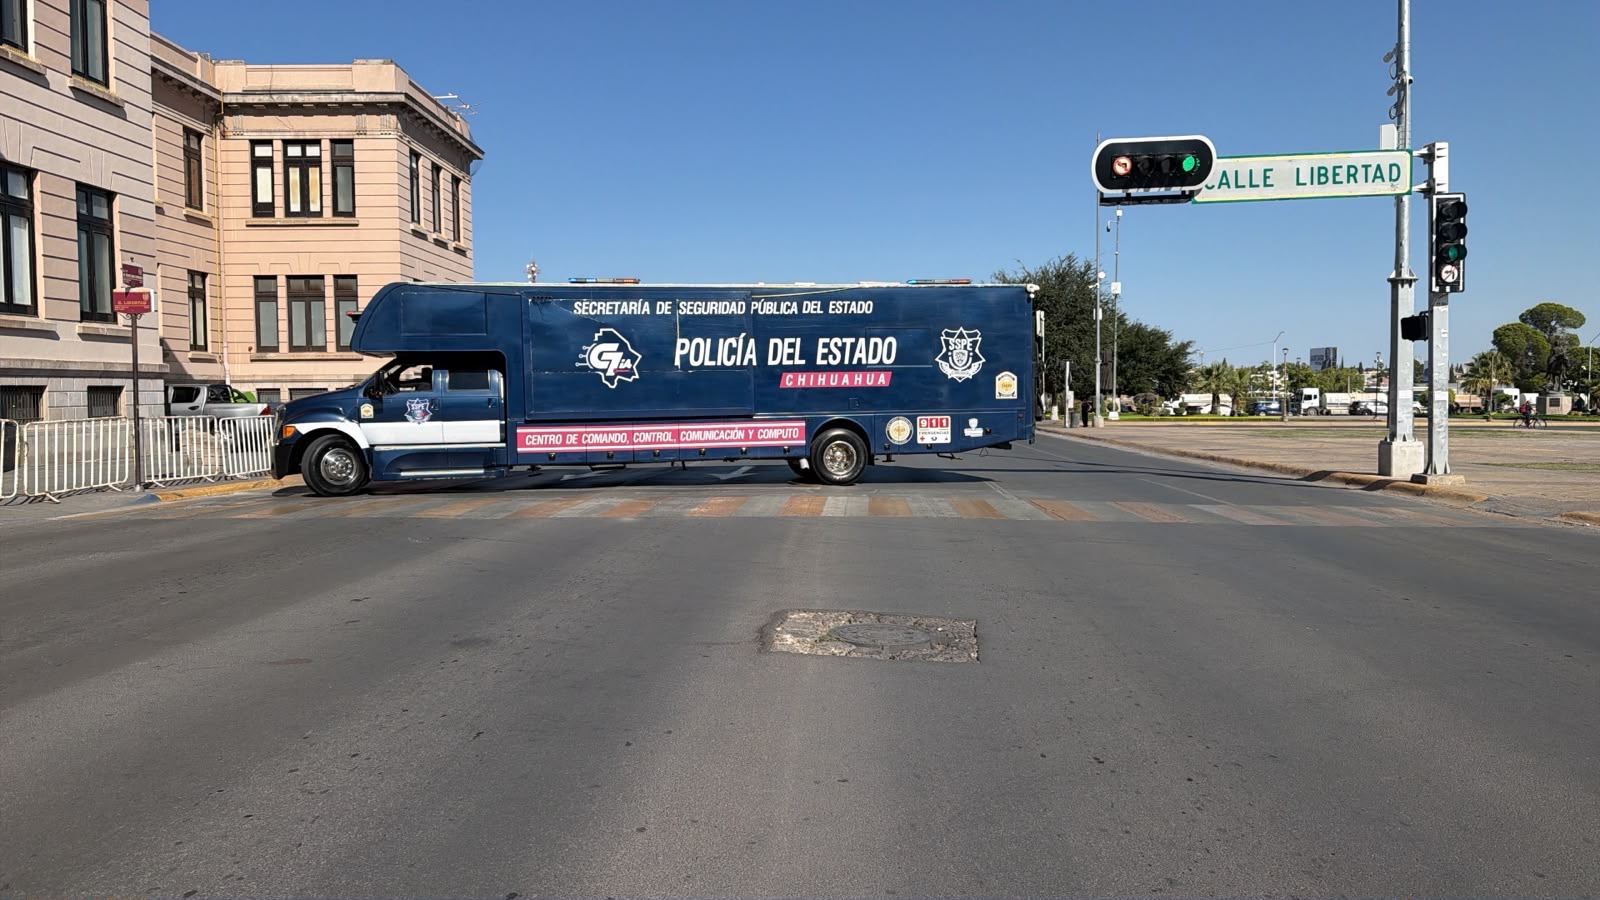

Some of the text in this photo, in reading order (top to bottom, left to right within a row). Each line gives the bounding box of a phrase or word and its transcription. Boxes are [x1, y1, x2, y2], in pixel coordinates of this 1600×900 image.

[1295, 162, 1401, 187] LIBERTAD
[573, 299, 874, 315] SECRETARÍA DE SEGURIDAD PÚBLICA DEL ESTADO
[674, 332, 898, 367] POLICÍA DEL ESTADO
[948, 338, 973, 351] SSPE
[785, 374, 886, 387] CHIHUAHUA
[920, 418, 948, 429] 911
[525, 427, 799, 445] CENTRO DE COMANDO, CONTROL, COMUNICACIÓN Y COMPUTO
